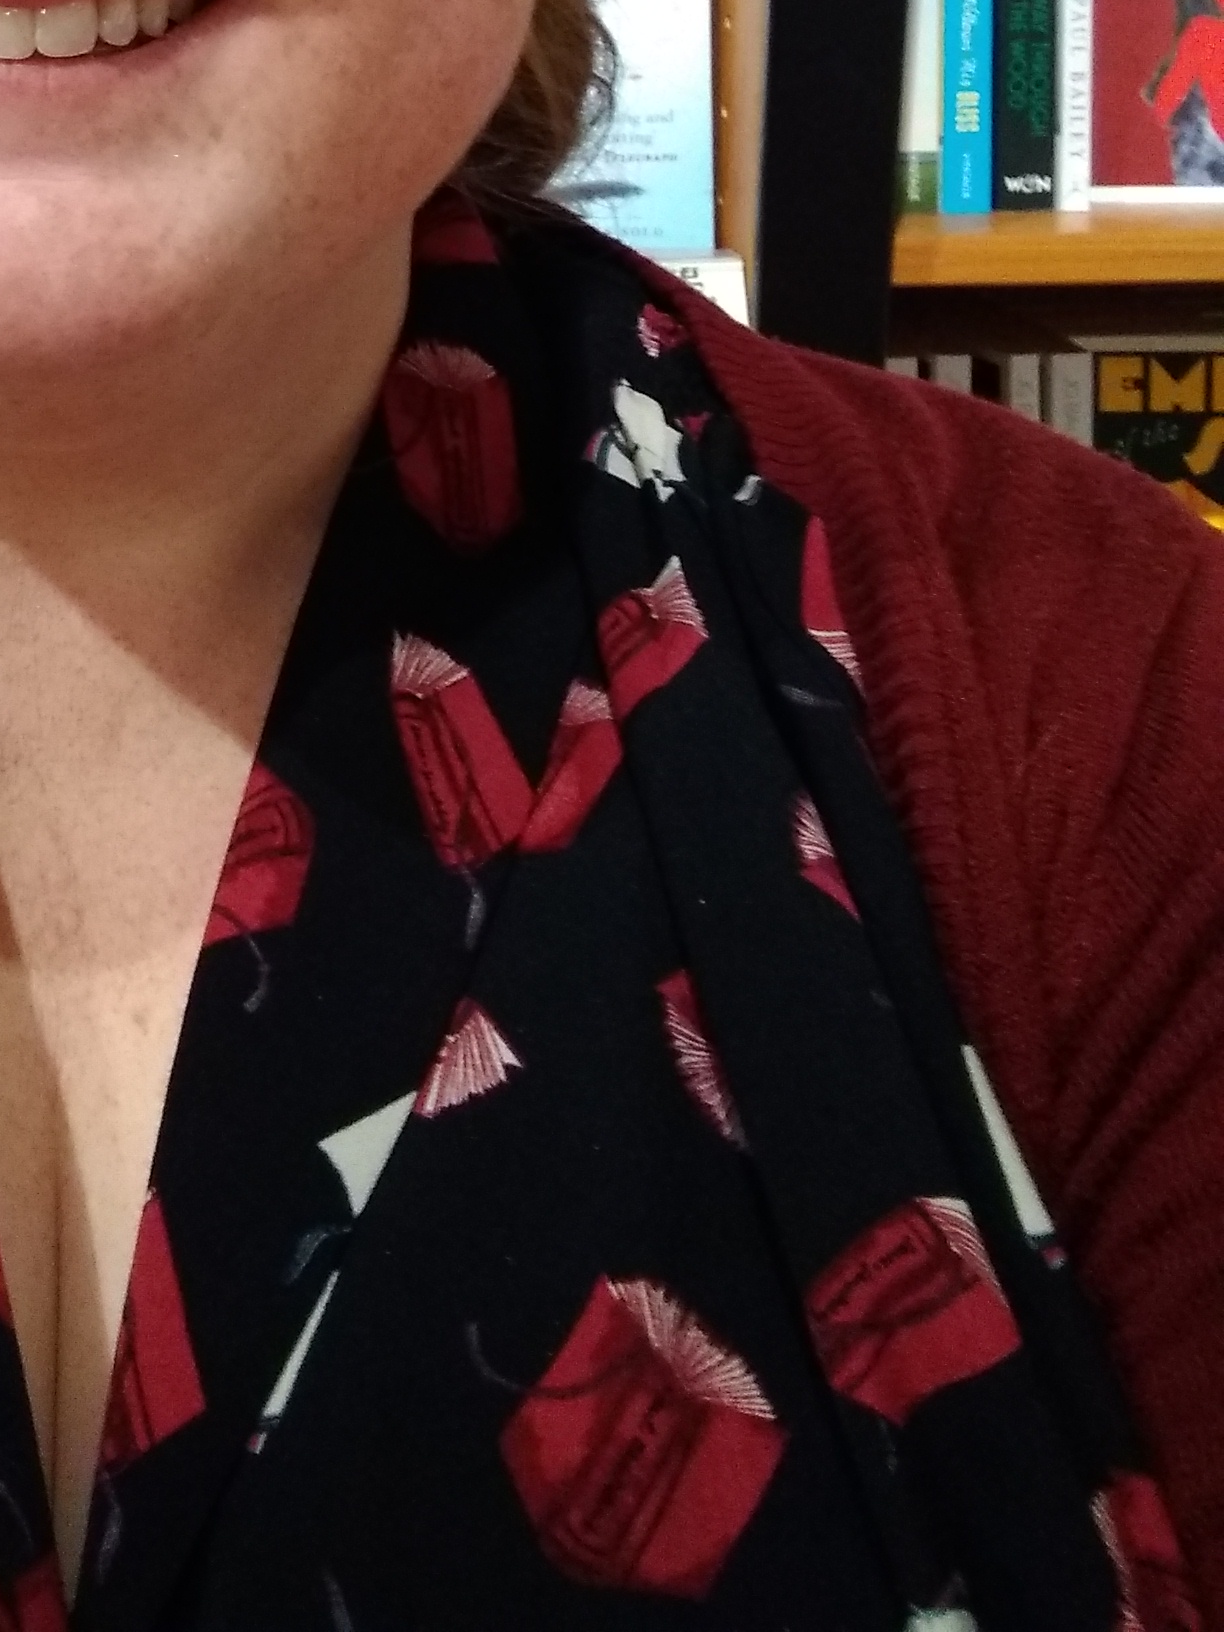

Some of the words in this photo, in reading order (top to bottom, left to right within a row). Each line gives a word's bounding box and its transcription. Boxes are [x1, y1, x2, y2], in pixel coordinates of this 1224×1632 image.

[1010, 0, 1028, 33] THE
[1008, 39, 1027, 109] WOOD
[1029, 39, 1049, 137] THROUGH
[1071, 70, 1087, 160] BAILEY
